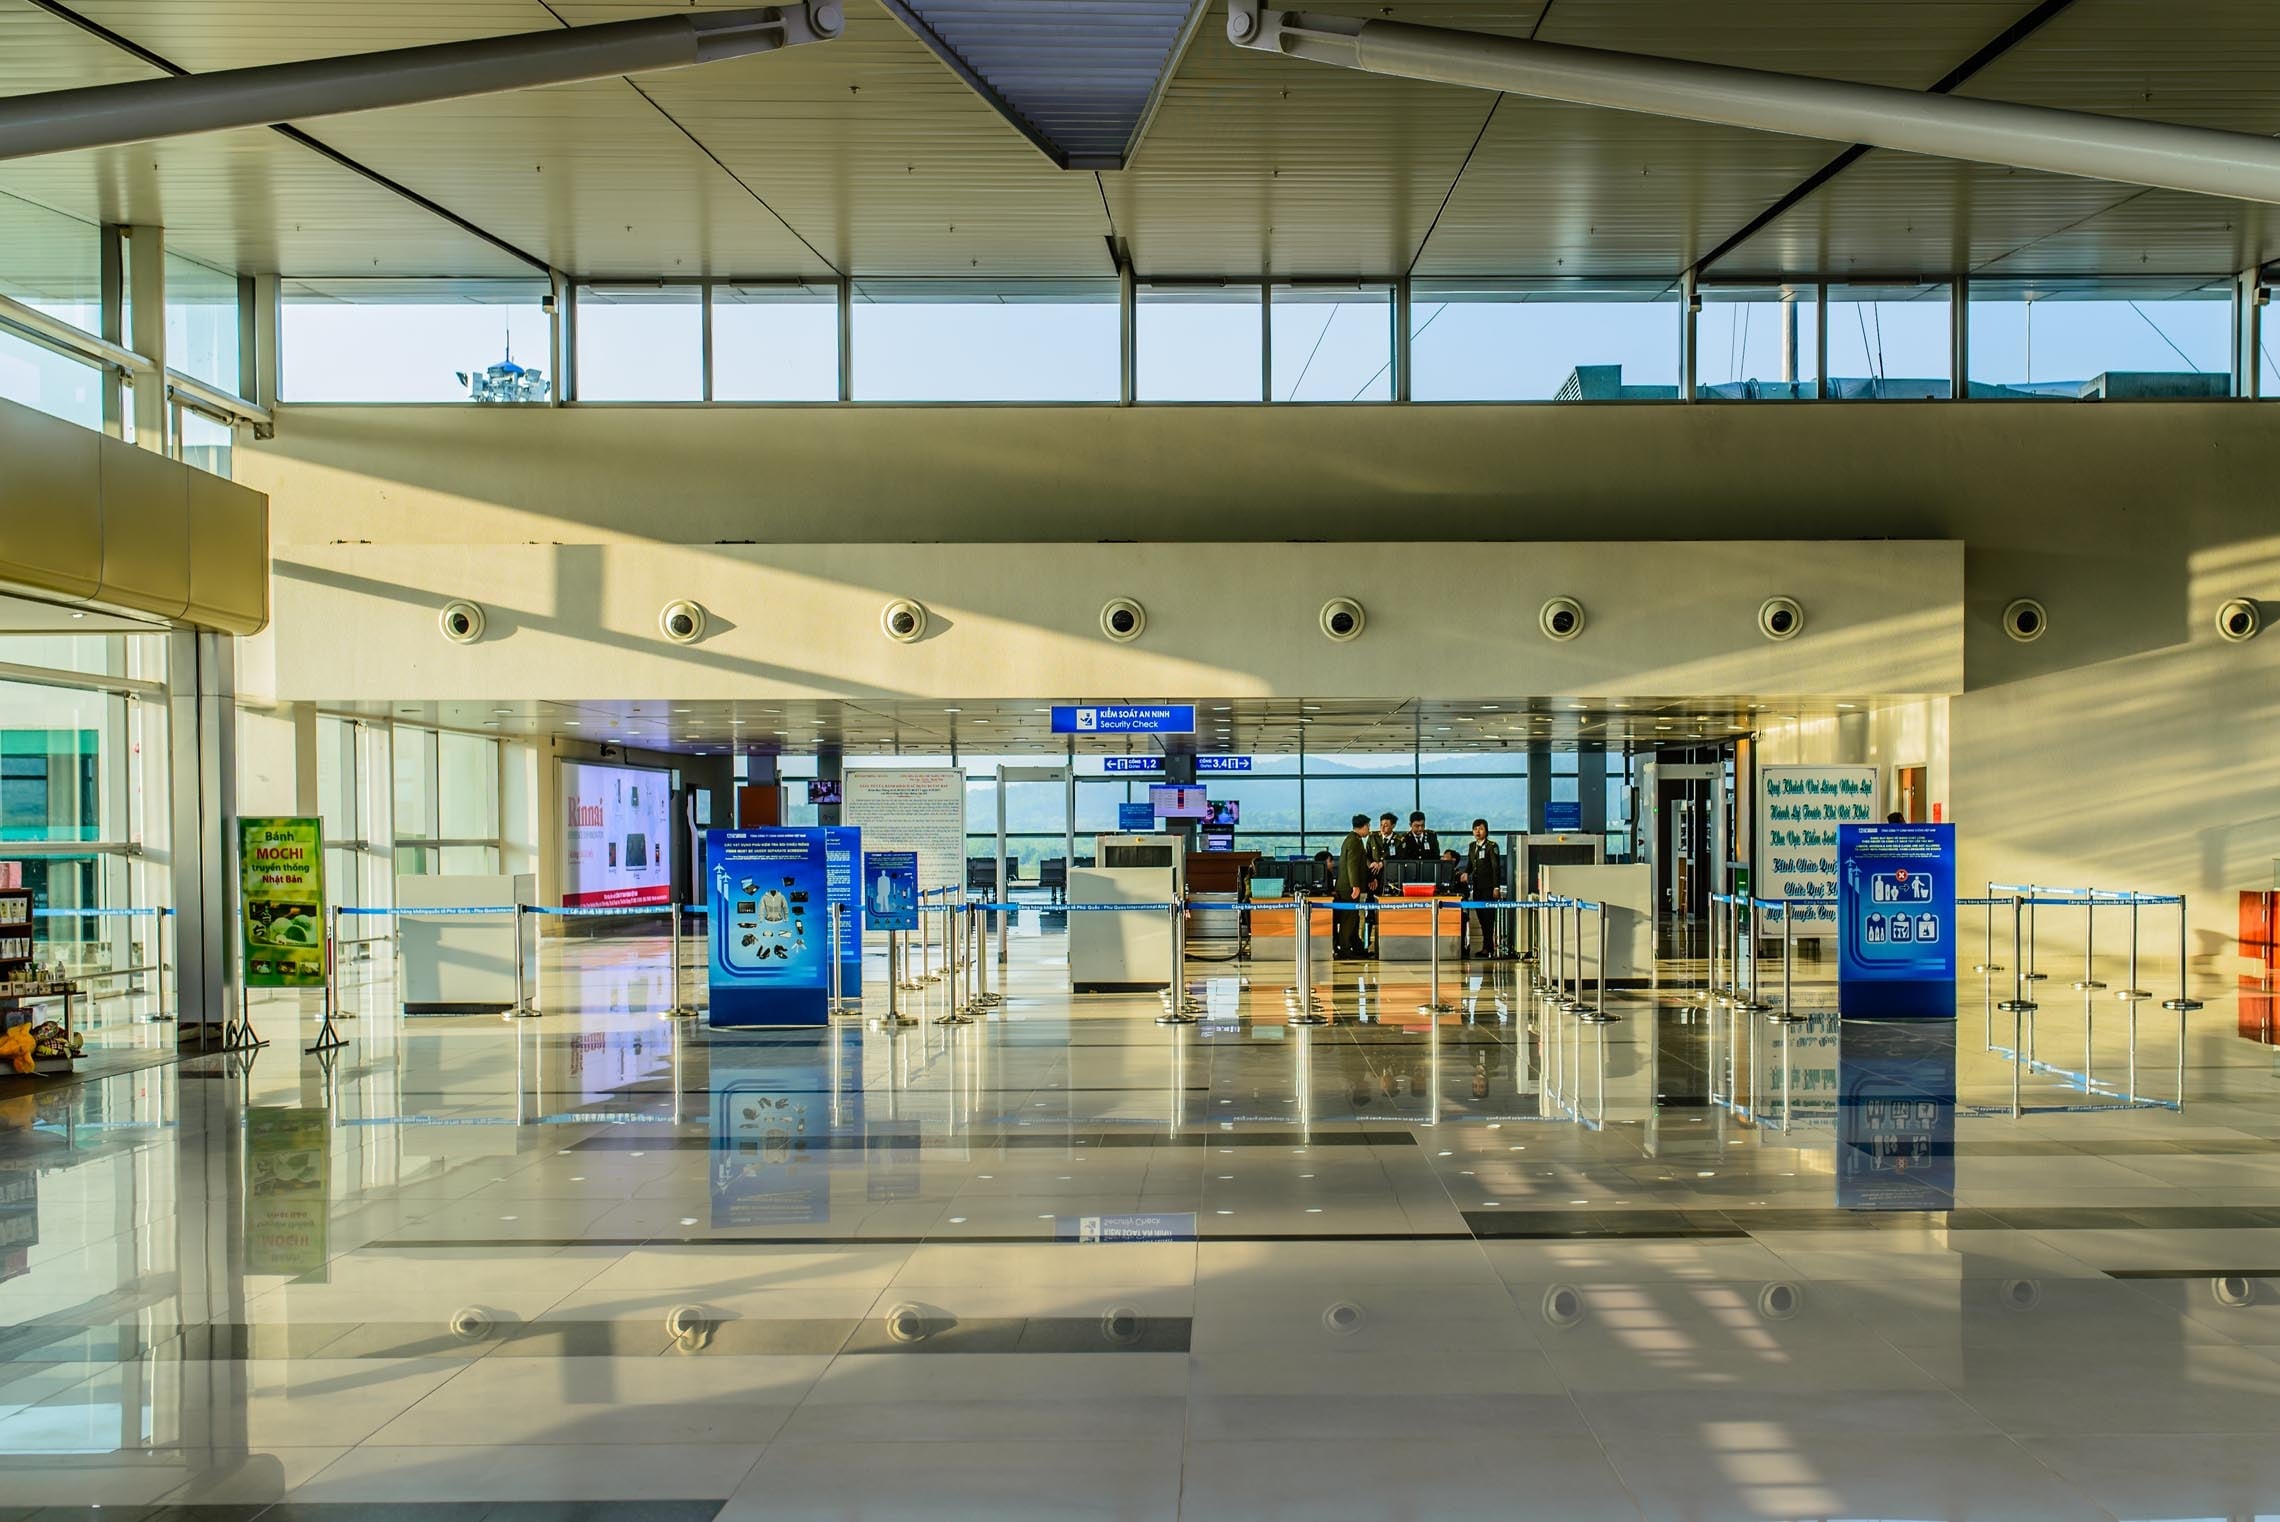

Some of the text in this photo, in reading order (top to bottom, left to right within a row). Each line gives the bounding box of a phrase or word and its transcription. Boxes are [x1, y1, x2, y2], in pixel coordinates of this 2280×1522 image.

[1100, 707, 1170, 719] KIỂM SOÁT AN NINH
[1100, 720, 1158, 729] Security Check
[568, 797, 603, 827] Rinnai
[265, 831, 294, 841] Bánh
[256, 848, 303, 860] MOCHI
